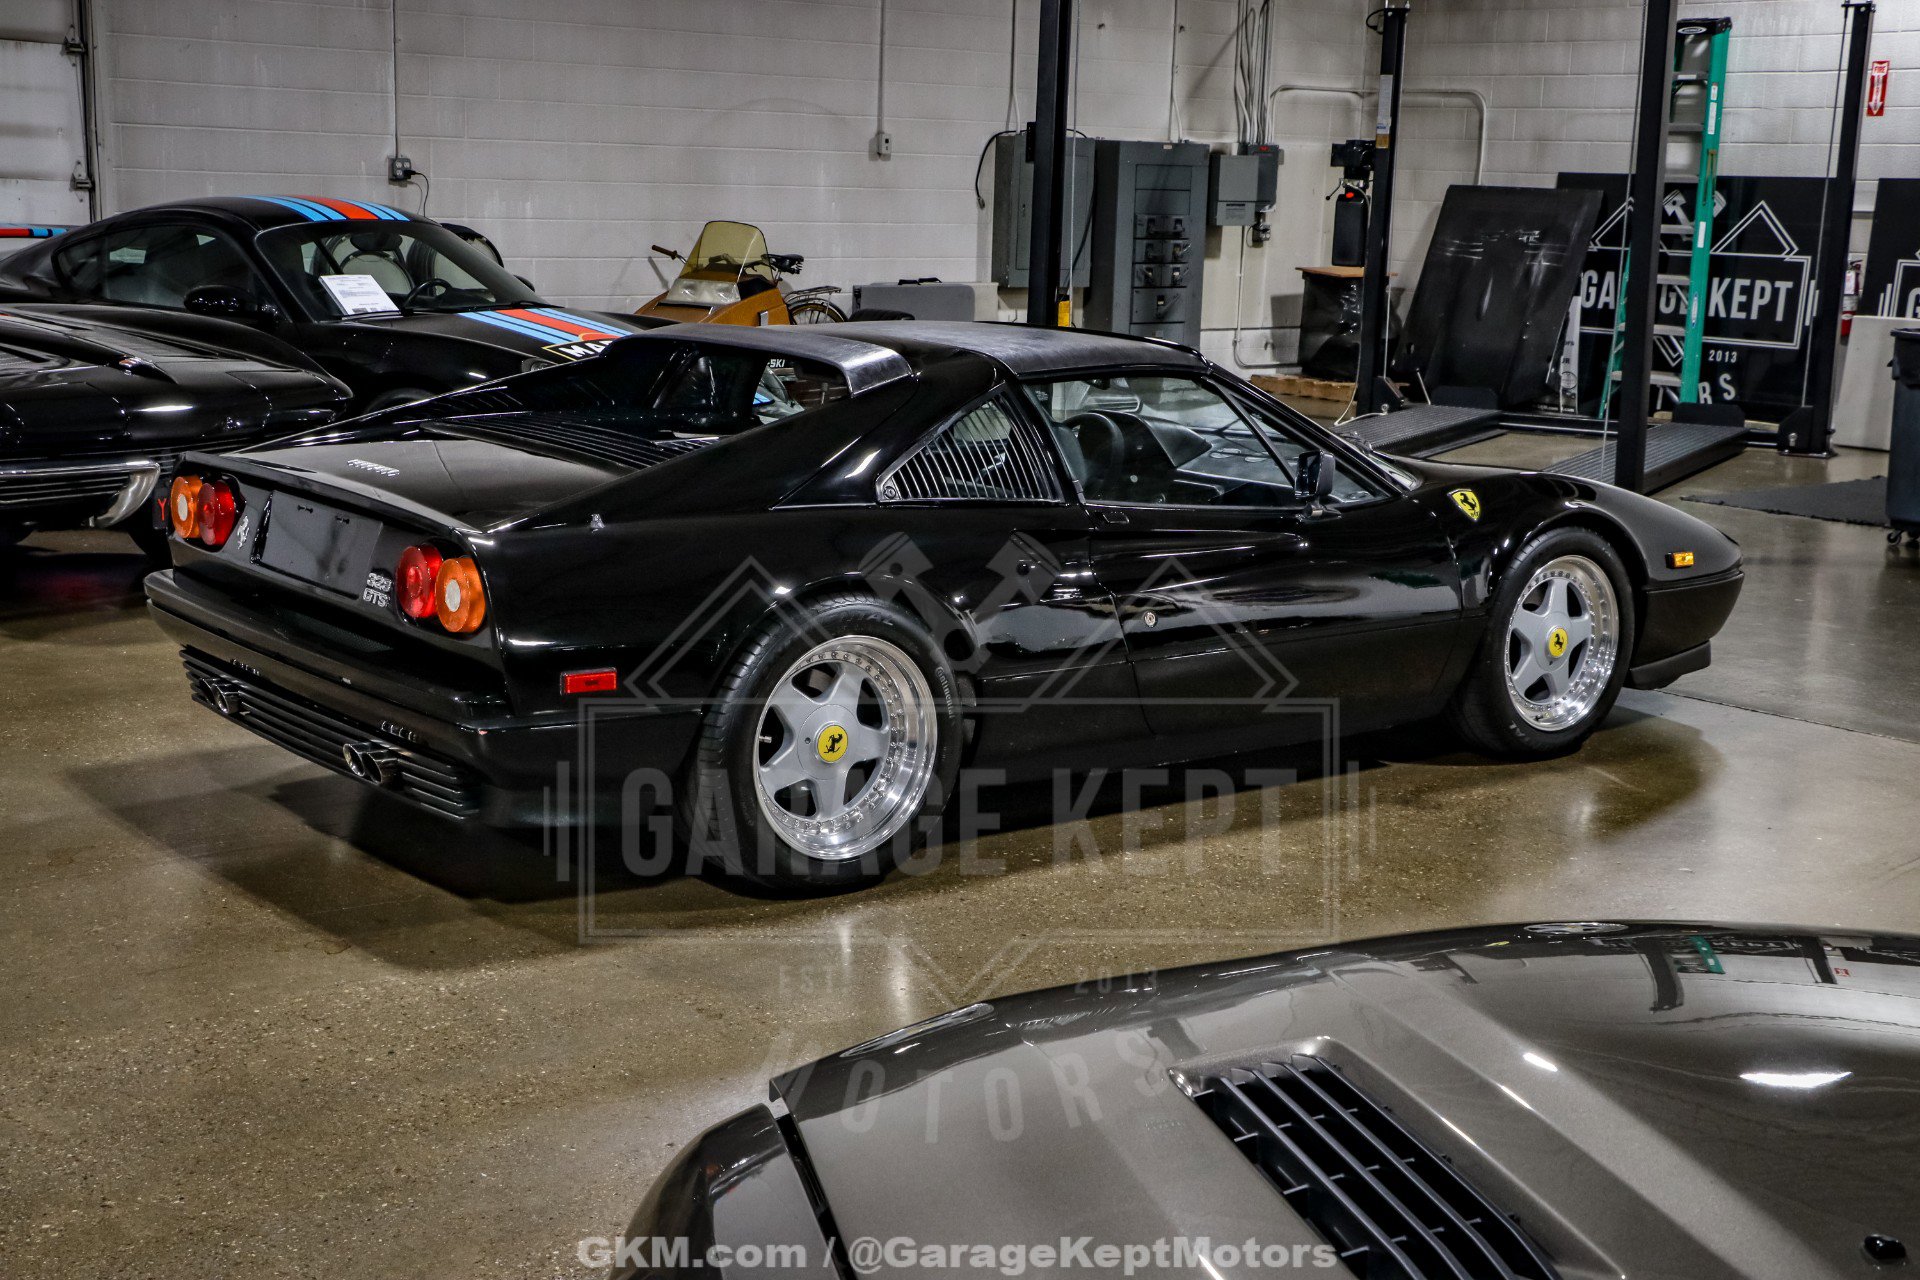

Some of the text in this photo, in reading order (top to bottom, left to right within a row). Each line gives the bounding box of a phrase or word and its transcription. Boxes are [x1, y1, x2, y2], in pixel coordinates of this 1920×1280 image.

[1708, 277, 1794, 322] KEPT
[1708, 350, 1738, 363] 2013
[363, 587, 388, 608] GTS
